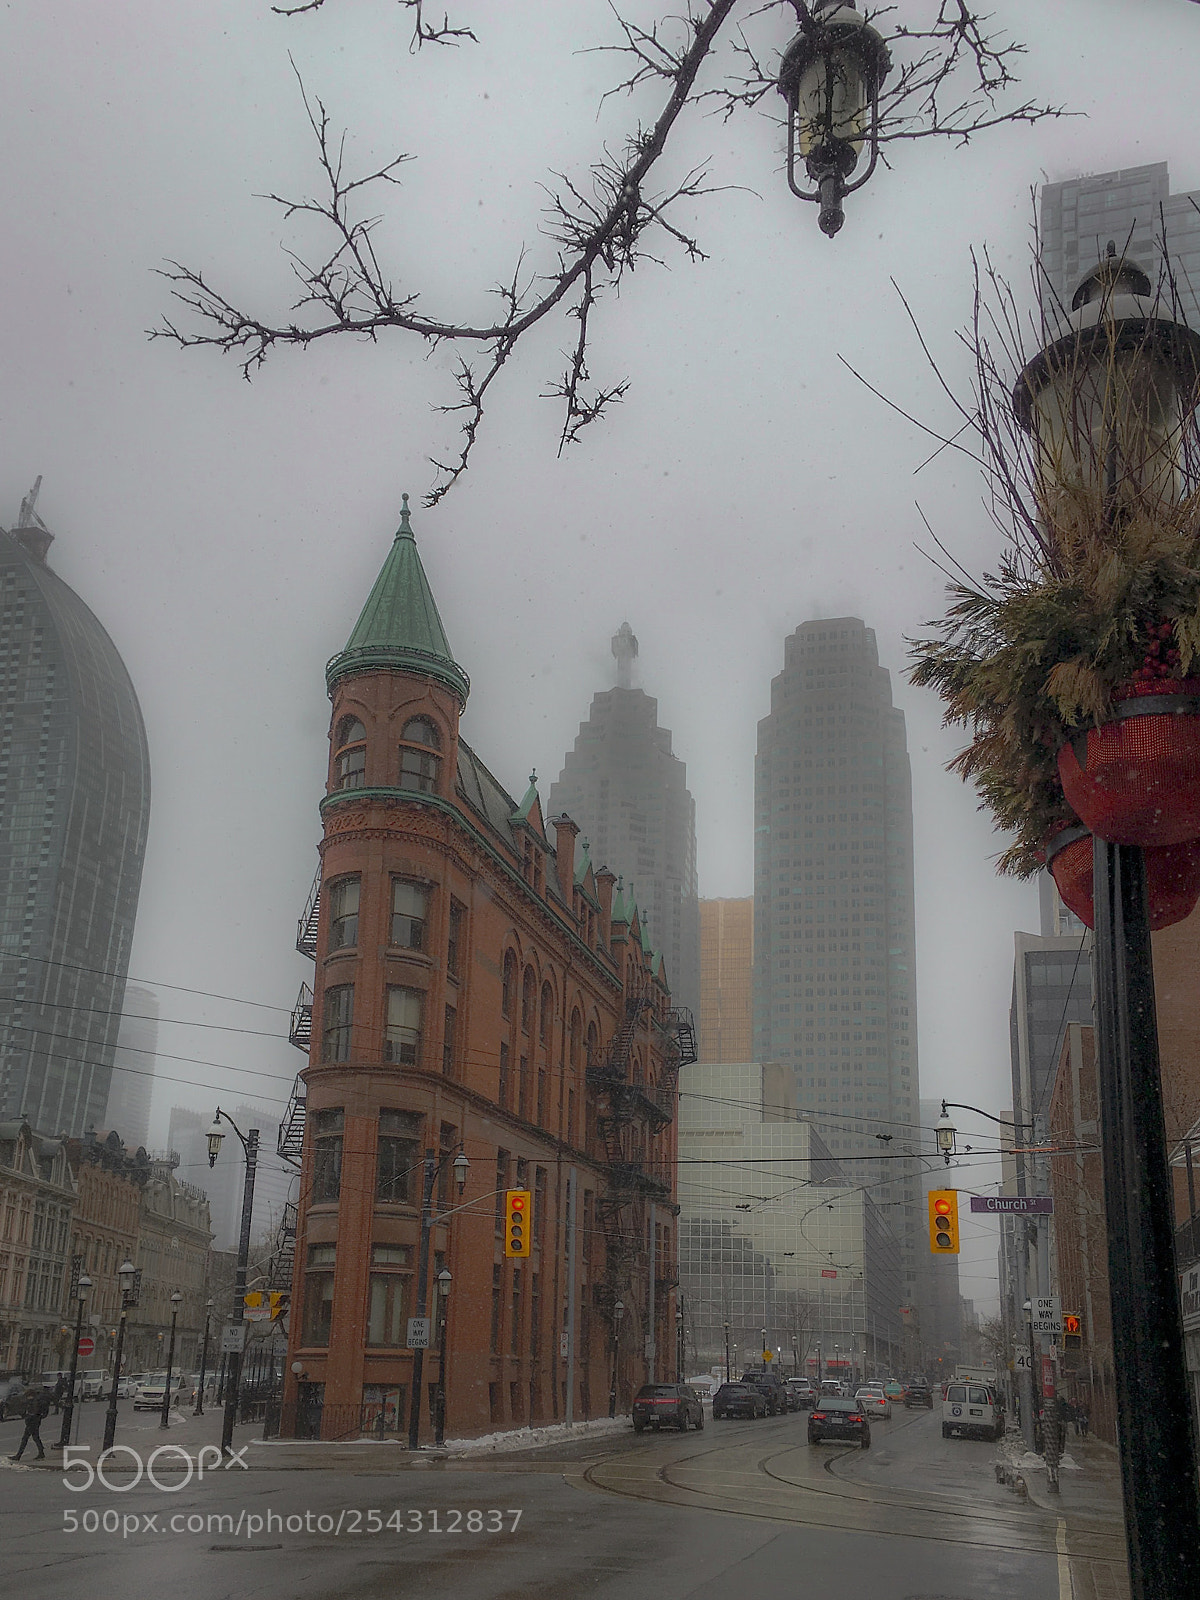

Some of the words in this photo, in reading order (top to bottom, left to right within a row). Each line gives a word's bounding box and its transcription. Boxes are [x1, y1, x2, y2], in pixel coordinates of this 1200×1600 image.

[986, 1198, 1027, 1210] Church
[1037, 1299, 1053, 1308] ONE
[1038, 1310, 1054, 1319] WAY
[412, 1320, 425, 1328] ONE
[1033, 1322, 1061, 1331] BEGINS
[229, 1328, 239, 1337] NO
[412, 1329, 425, 1337] WAY
[407, 1338, 428, 1346] BEGINS
[1017, 1356, 1032, 1368] 40
